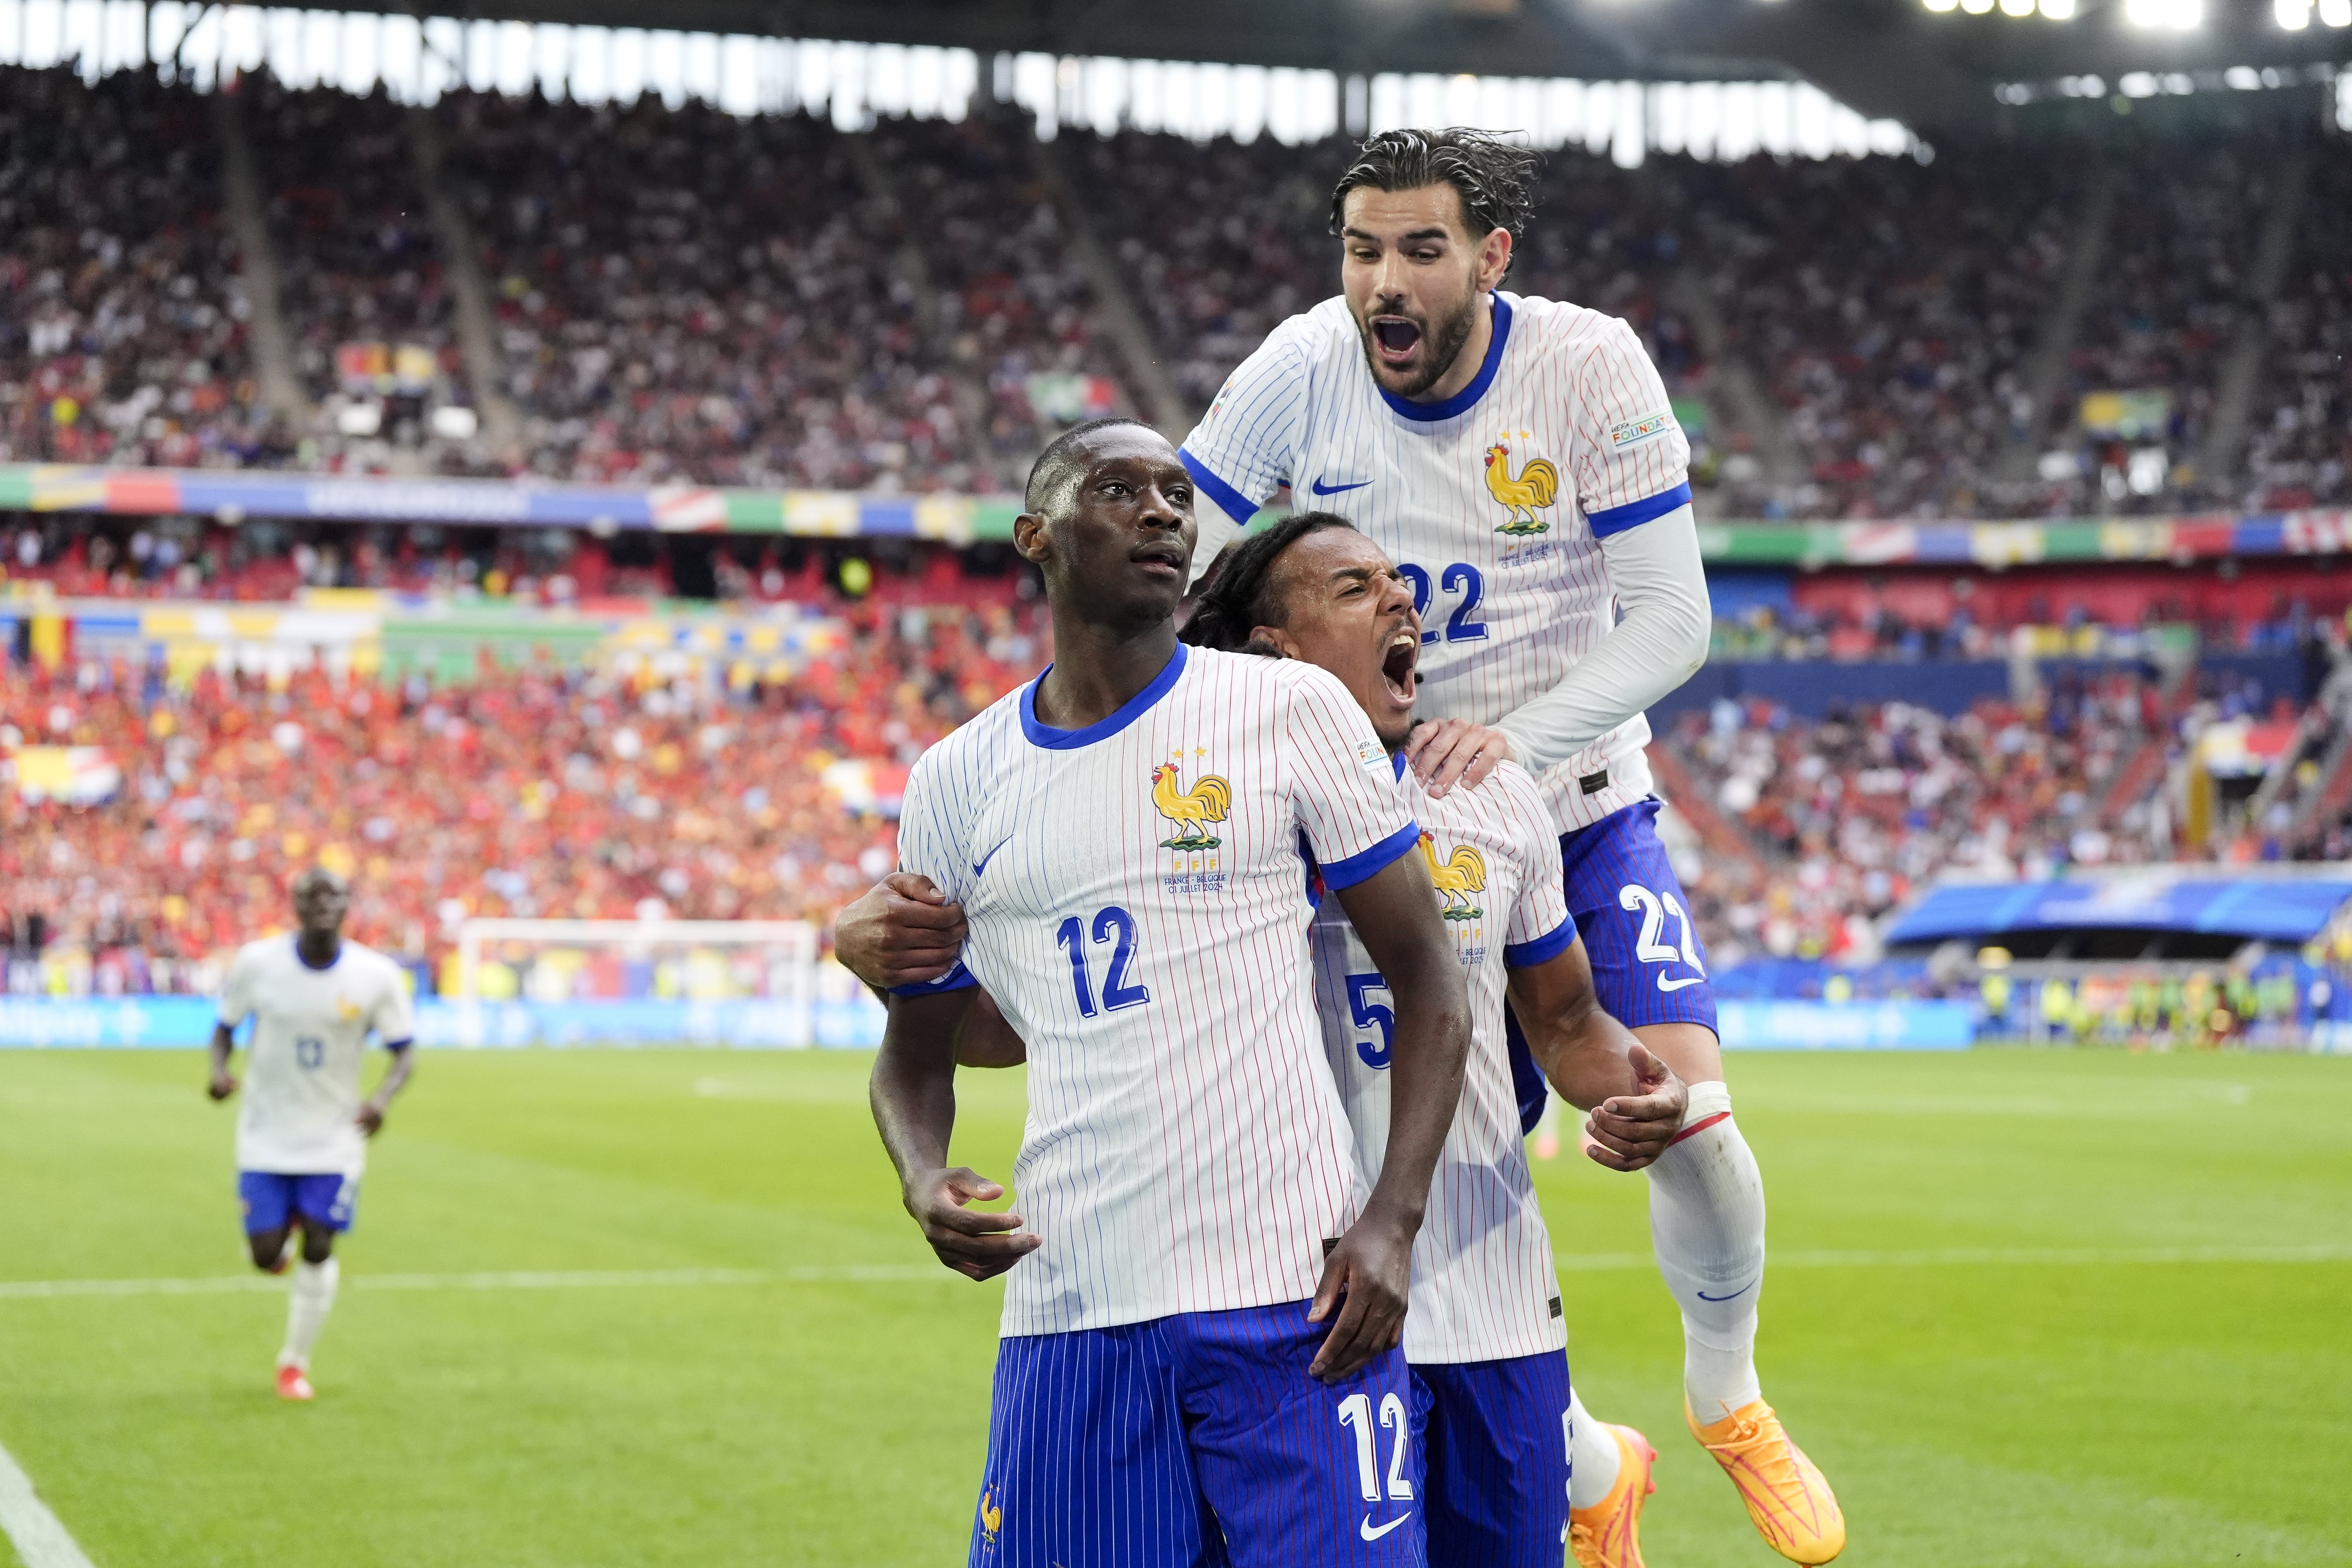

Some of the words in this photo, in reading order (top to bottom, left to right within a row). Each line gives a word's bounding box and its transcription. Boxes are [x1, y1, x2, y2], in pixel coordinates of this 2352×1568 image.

[1612, 423, 1629, 432] UEFA
[1613, 415, 1673, 443] FOUNDATIO
[1396, 562, 1489, 646] 22
[1357, 741, 1370, 750] UEFA
[1360, 746, 1384, 761] FOUN
[1165, 876, 1189, 886] FRANCE
[1197, 874, 1226, 883] BELGIQUE
[1179, 884, 1201, 893] JUILLET
[1203, 883, 1223, 891] 2024
[1619, 884, 1706, 978] 22
[1057, 906, 1150, 1019] 12
[1345, 973, 1394, 1070] 5
[1338, 1392, 1413, 1502] 12
